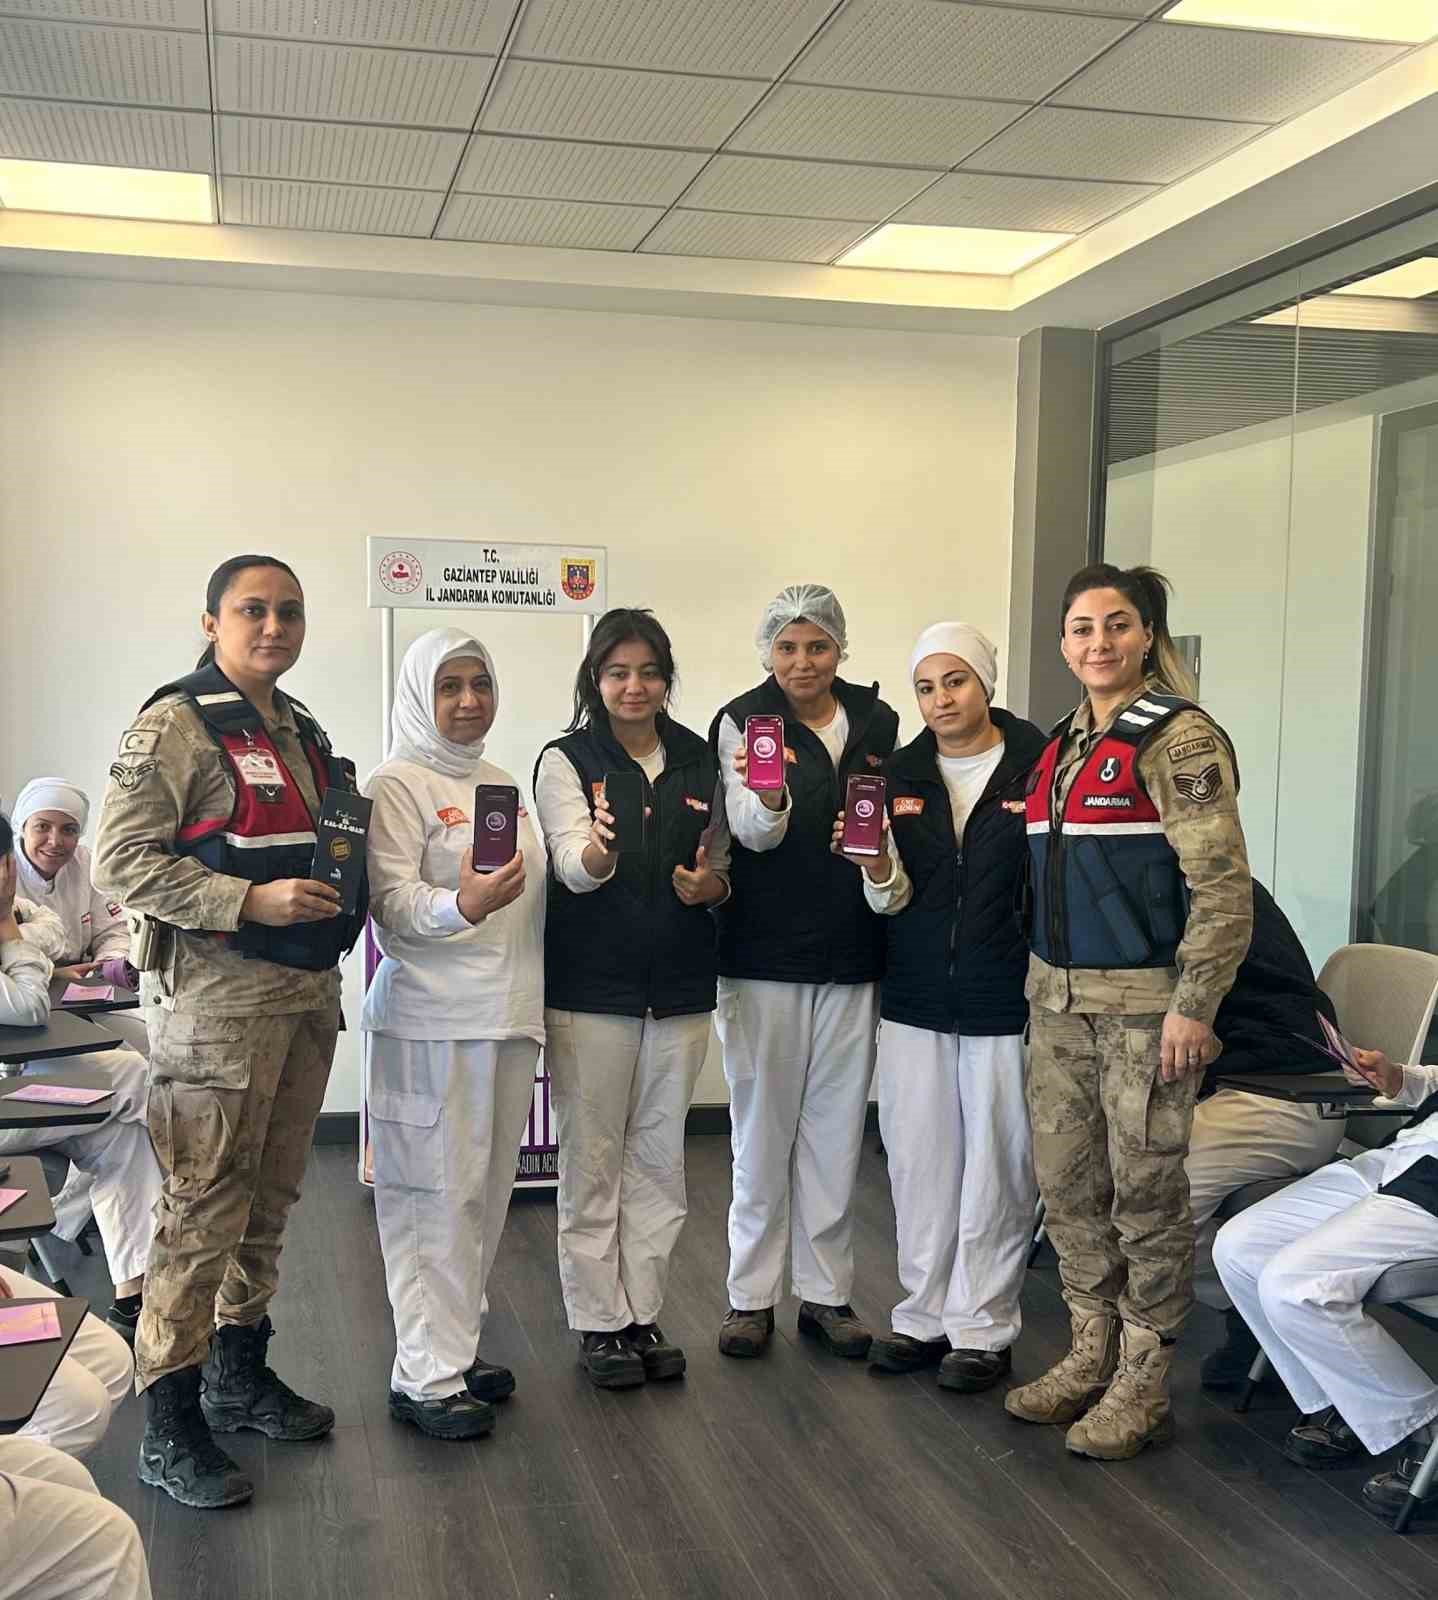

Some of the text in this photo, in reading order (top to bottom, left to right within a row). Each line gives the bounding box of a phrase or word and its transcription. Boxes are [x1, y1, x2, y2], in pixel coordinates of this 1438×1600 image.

[482, 549, 500, 563] T.C.
[443, 565, 497, 583] GAZİANTEP
[499, 567, 539, 585] VALİLİĞİ
[426, 584, 556, 606] İL JANDARMA KOMUTANLIĞI
[1084, 796, 1130, 807] JANDARMA
[519, 1153, 541, 1174] ADIN
